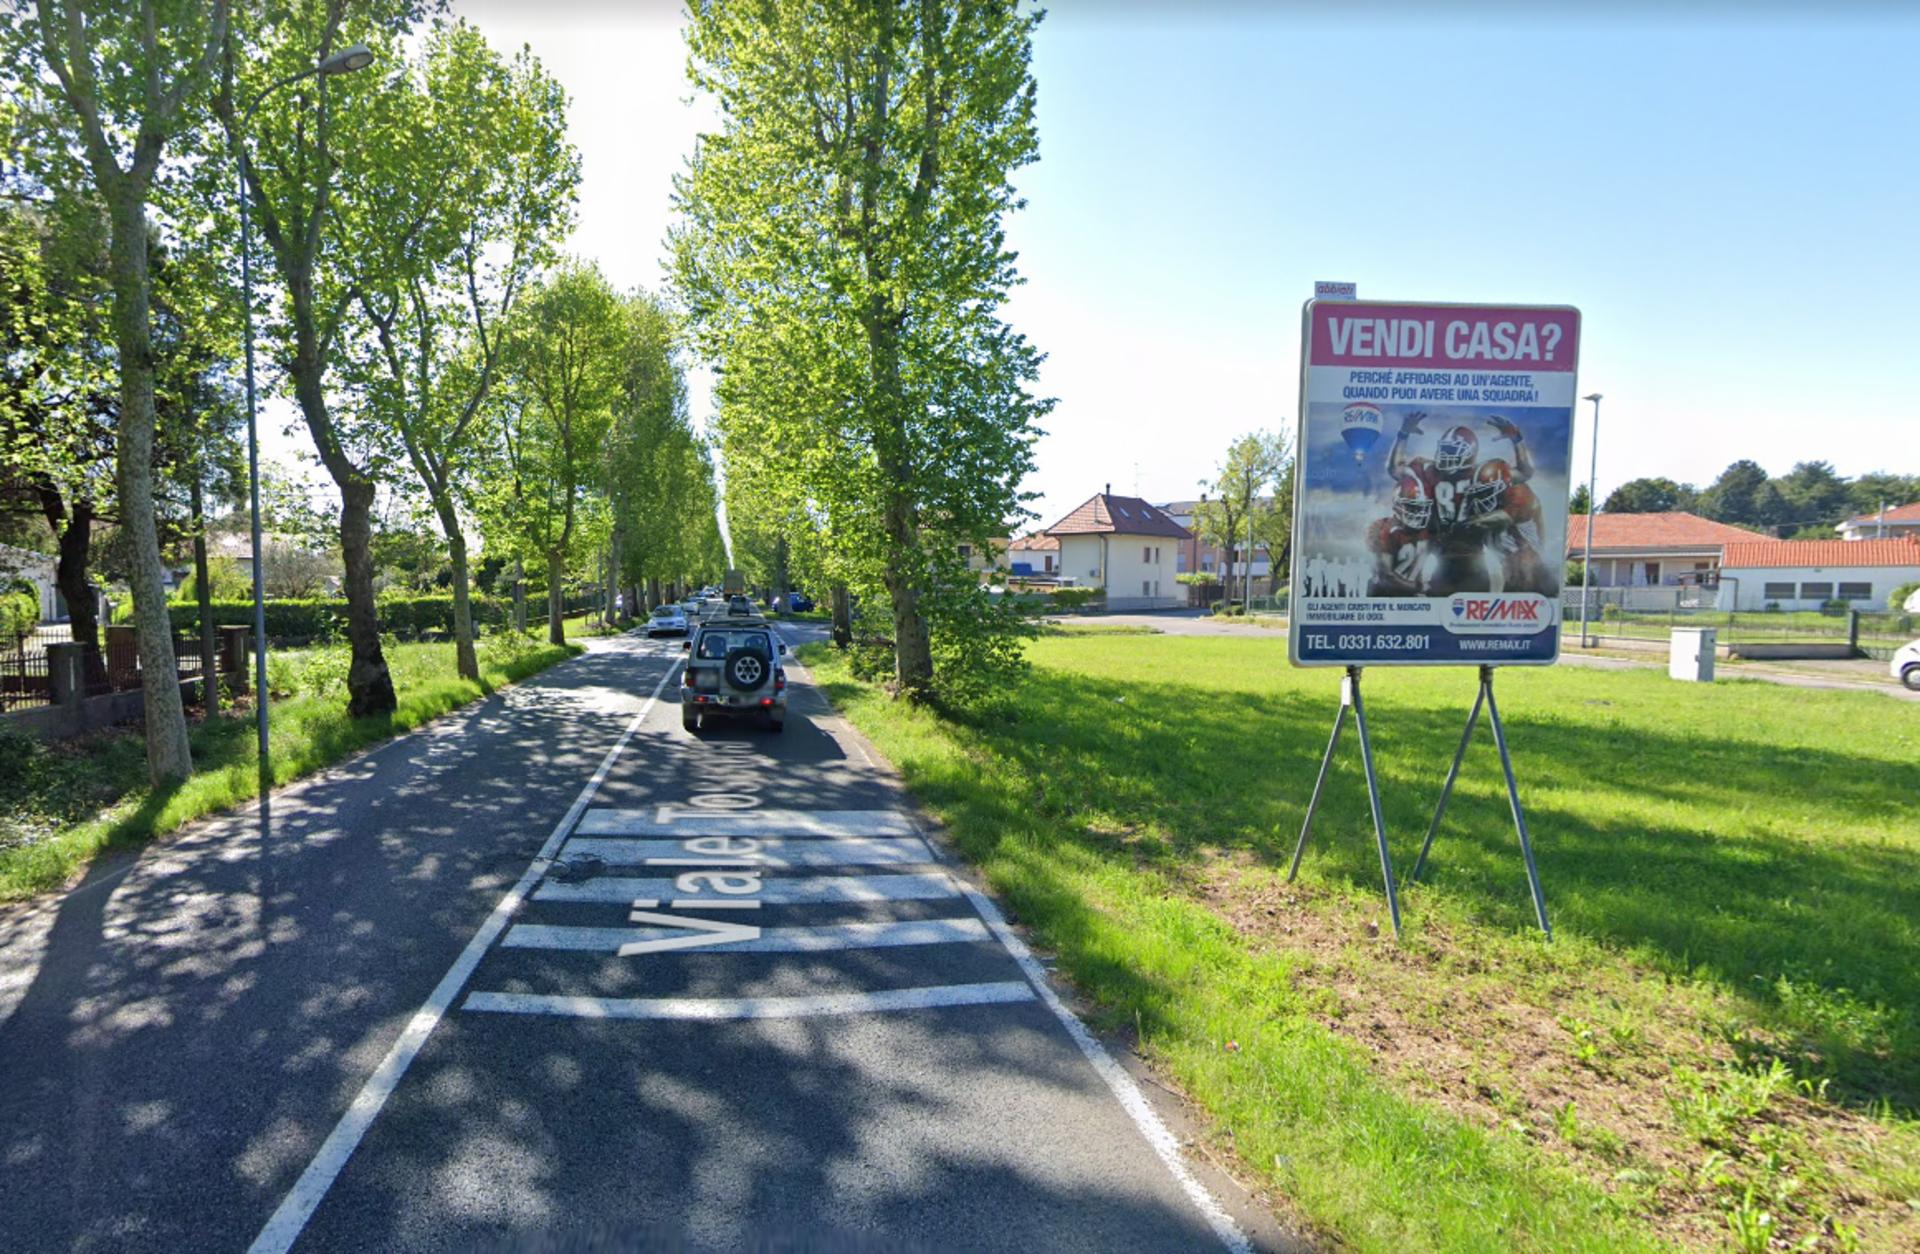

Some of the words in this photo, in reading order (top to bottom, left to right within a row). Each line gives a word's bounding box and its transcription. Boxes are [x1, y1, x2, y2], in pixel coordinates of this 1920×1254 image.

[1328, 317, 1435, 358] VENDI
[1445, 320, 1562, 361] CASA?
[1350, 369, 1392, 384] PERCHÉ
[1395, 372, 1450, 385] AFFIDARSI
[1454, 373, 1469, 385] AD
[1472, 374, 1534, 388] UN'AGENTE,
[1343, 386, 1389, 400] QUANDO
[1392, 387, 1417, 400] PUOI
[1420, 388, 1454, 401] AVERE
[1457, 388, 1480, 401] UNA
[1306, 634, 1335, 650] TEL.
[1338, 634, 1430, 650] 0331.632.801
[1459, 639, 1532, 651] WWW.REMAX.IT
